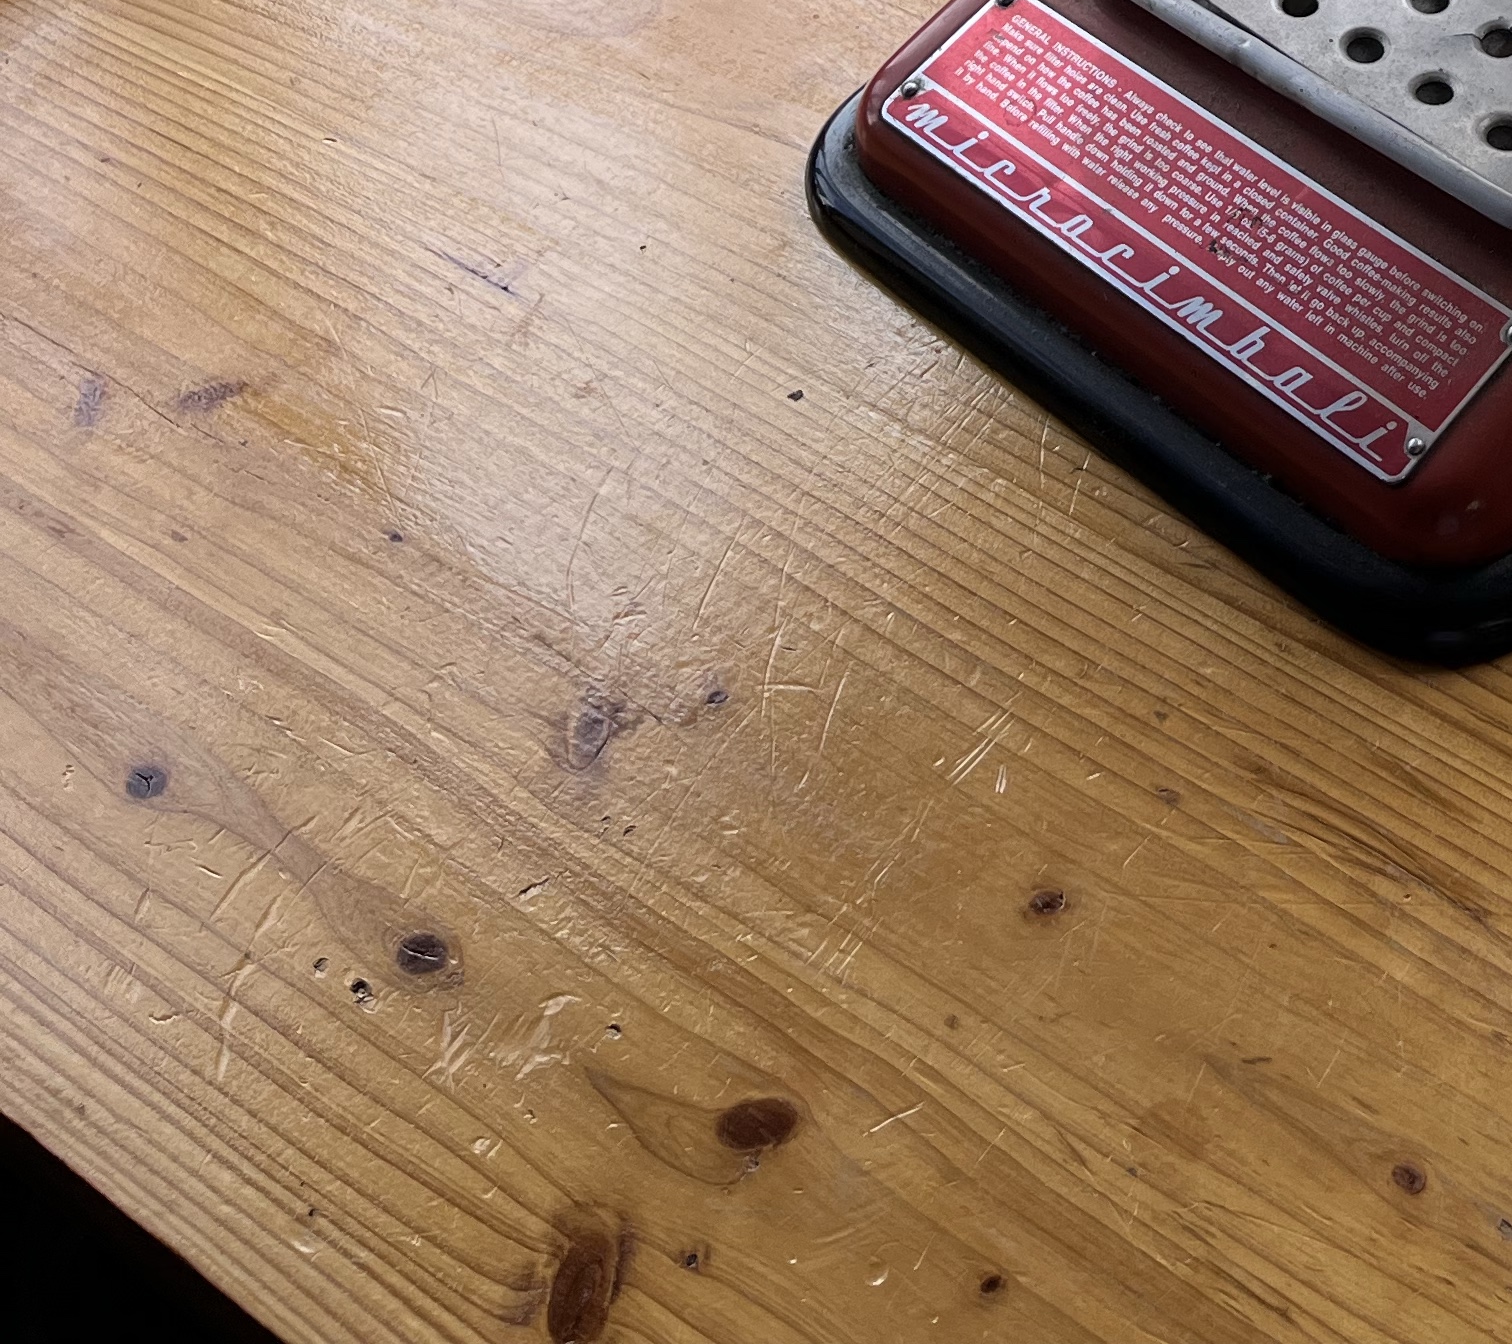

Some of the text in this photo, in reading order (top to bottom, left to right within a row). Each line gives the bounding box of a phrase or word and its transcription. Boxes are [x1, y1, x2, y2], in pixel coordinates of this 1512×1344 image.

[954, 67, 965, 77] it
[962, 73, 976, 86] by
[975, 81, 999, 102] hand.
[999, 99, 1028, 122] Before
[1028, 119, 1061, 146] refilling
[1061, 142, 1081, 159] with
[1081, 156, 1107, 176] water
[1107, 175, 1140, 200] release
[1140, 198, 1159, 214] any
[1161, 214, 1203, 245] pressure.
[1237, 265, 1256, 280] out
[1255, 278, 1275, 294] any
[1276, 291, 1304, 313] water
[1304, 309, 1324, 326] left
[1323, 322, 1336, 335] in
[1337, 333, 1379, 364] machine
[1380, 363, 1406, 382] after
[1407, 381, 1427, 400] use.
[960, 59, 986, 76] right
[981, 72, 1009, 95] hand
[1006, 89, 1035, 112] switch.
[1036, 108, 1057, 127] Pull
[1054, 121, 1084, 145] handle
[1085, 143, 1110, 163] down
[1110, 159, 1143, 187] holding
[1143, 182, 1155, 193] it
[1153, 190, 1179, 211] down
[1179, 206, 1194, 221] for
[1201, 222, 1221, 239] few
[1217, 236, 1259, 267] seconds.
[1262, 262, 1287, 284] Then
[1300, 290, 1312, 301] it
[1308, 298, 1325, 310] go
[1325, 306, 1350, 328] back
[1369, 338, 1439, 390] accompanying
[972, 49, 989, 67] the
[984, 61, 1016, 85] coffee
[1016, 78, 1027, 90] in
[1023, 86, 1043, 101] the
[1042, 97, 1064, 118] filter.
[1067, 113, 1093, 135] When
[1093, 131, 1110, 146] the
[1110, 144, 1133, 162] right
[1133, 160, 1169, 188] working
[1167, 185, 1208, 214] pressure
[1209, 211, 1221, 223] in
[1222, 222, 1262, 250] reached
[1262, 249, 1284, 265] and
[1284, 263, 1314, 287] safety
[1316, 284, 1342, 305] valve
[1388, 332, 1410, 351] turn
[1412, 350, 1430, 364] off
[1430, 361, 1449, 378] the
[982, 40, 1000, 57] fine.
[1003, 53, 1027, 74] When
[1022, 70, 1037, 81] it
[1035, 76, 1059, 96] flows
[1059, 92, 1075, 107] too
[1102, 122, 1119, 137] the
[1117, 135, 1145, 154] grind
[1143, 149, 1154, 161] is
[1154, 157, 1171, 172] too
[1171, 171, 1202, 196] coarse.
[1204, 191, 1224, 208] Use
[1274, 241, 1310, 267] grams)
[1310, 264, 1324, 275] of
[1323, 272, 1353, 296] coffee
[1351, 293, 1372, 307] per
[1372, 306, 1392, 322] cup
[1393, 320, 1416, 337] and
[1415, 335, 1459, 367] compact
[991, 33, 1025, 57] pend
[1023, 54, 1037, 66] on
[1033, 61, 1057, 79] how
[1056, 75, 1072, 90] the
[1073, 88, 1100, 109] coffee
[1100, 105, 1119, 121] has
[1118, 117, 1142, 137] been
[1142, 135, 1178, 161] roasted
[1176, 158, 1198, 174] and
[1195, 172, 1231, 197] ground.
[1233, 193, 1259, 217] When
[1258, 212, 1277, 228] the
[1277, 226, 1307, 249] coffee
[1308, 245, 1335, 267] flows
[1336, 263, 1353, 279] too
[1389, 299, 1407, 315] the
[1406, 313, 1437, 334] grind
[1436, 330, 1448, 343] is
[1449, 339, 1468, 356] too
[1000, 22, 1025, 42] Make
[1024, 39, 1044, 55] sure
[1043, 51, 1065, 68] filter
[1063, 64, 1088, 85] holes
[1086, 82, 1104, 95] are
[1103, 93, 1128, 113] clean.
[1130, 109, 1148, 126] Use
[1148, 121, 1172, 141] fresh
[1171, 139, 1200, 160] coffee
[1200, 156, 1223, 175] kept
[1221, 170, 1233, 183] in
[1242, 186, 1276, 210] closed
[1323, 238, 1352, 261] Good
[1351, 258, 1417, 307] coffee-making
[1418, 304, 1453, 329] results
[1454, 327, 1477, 345] also
[1011, 14, 1051, 45] GENERAL
[1052, 42, 1117, 88] INSTRUCTIONS
[1123, 90, 1155, 114] Always
[1155, 112, 1183, 133] check
[1183, 129, 1195, 141] to
[1194, 139, 1213, 153] see
[1213, 150, 1235, 167] that
[1232, 162, 1259, 183] water
[1257, 178, 1282, 198] level
[1279, 193, 1291, 205] is
[1291, 201, 1321, 225] visible
[1320, 220, 1333, 233] in
[1330, 230, 1358, 250] glass
[1356, 247, 1389, 270] gauge
[1388, 265, 1421, 291] before
[1421, 288, 1468, 324] switching
